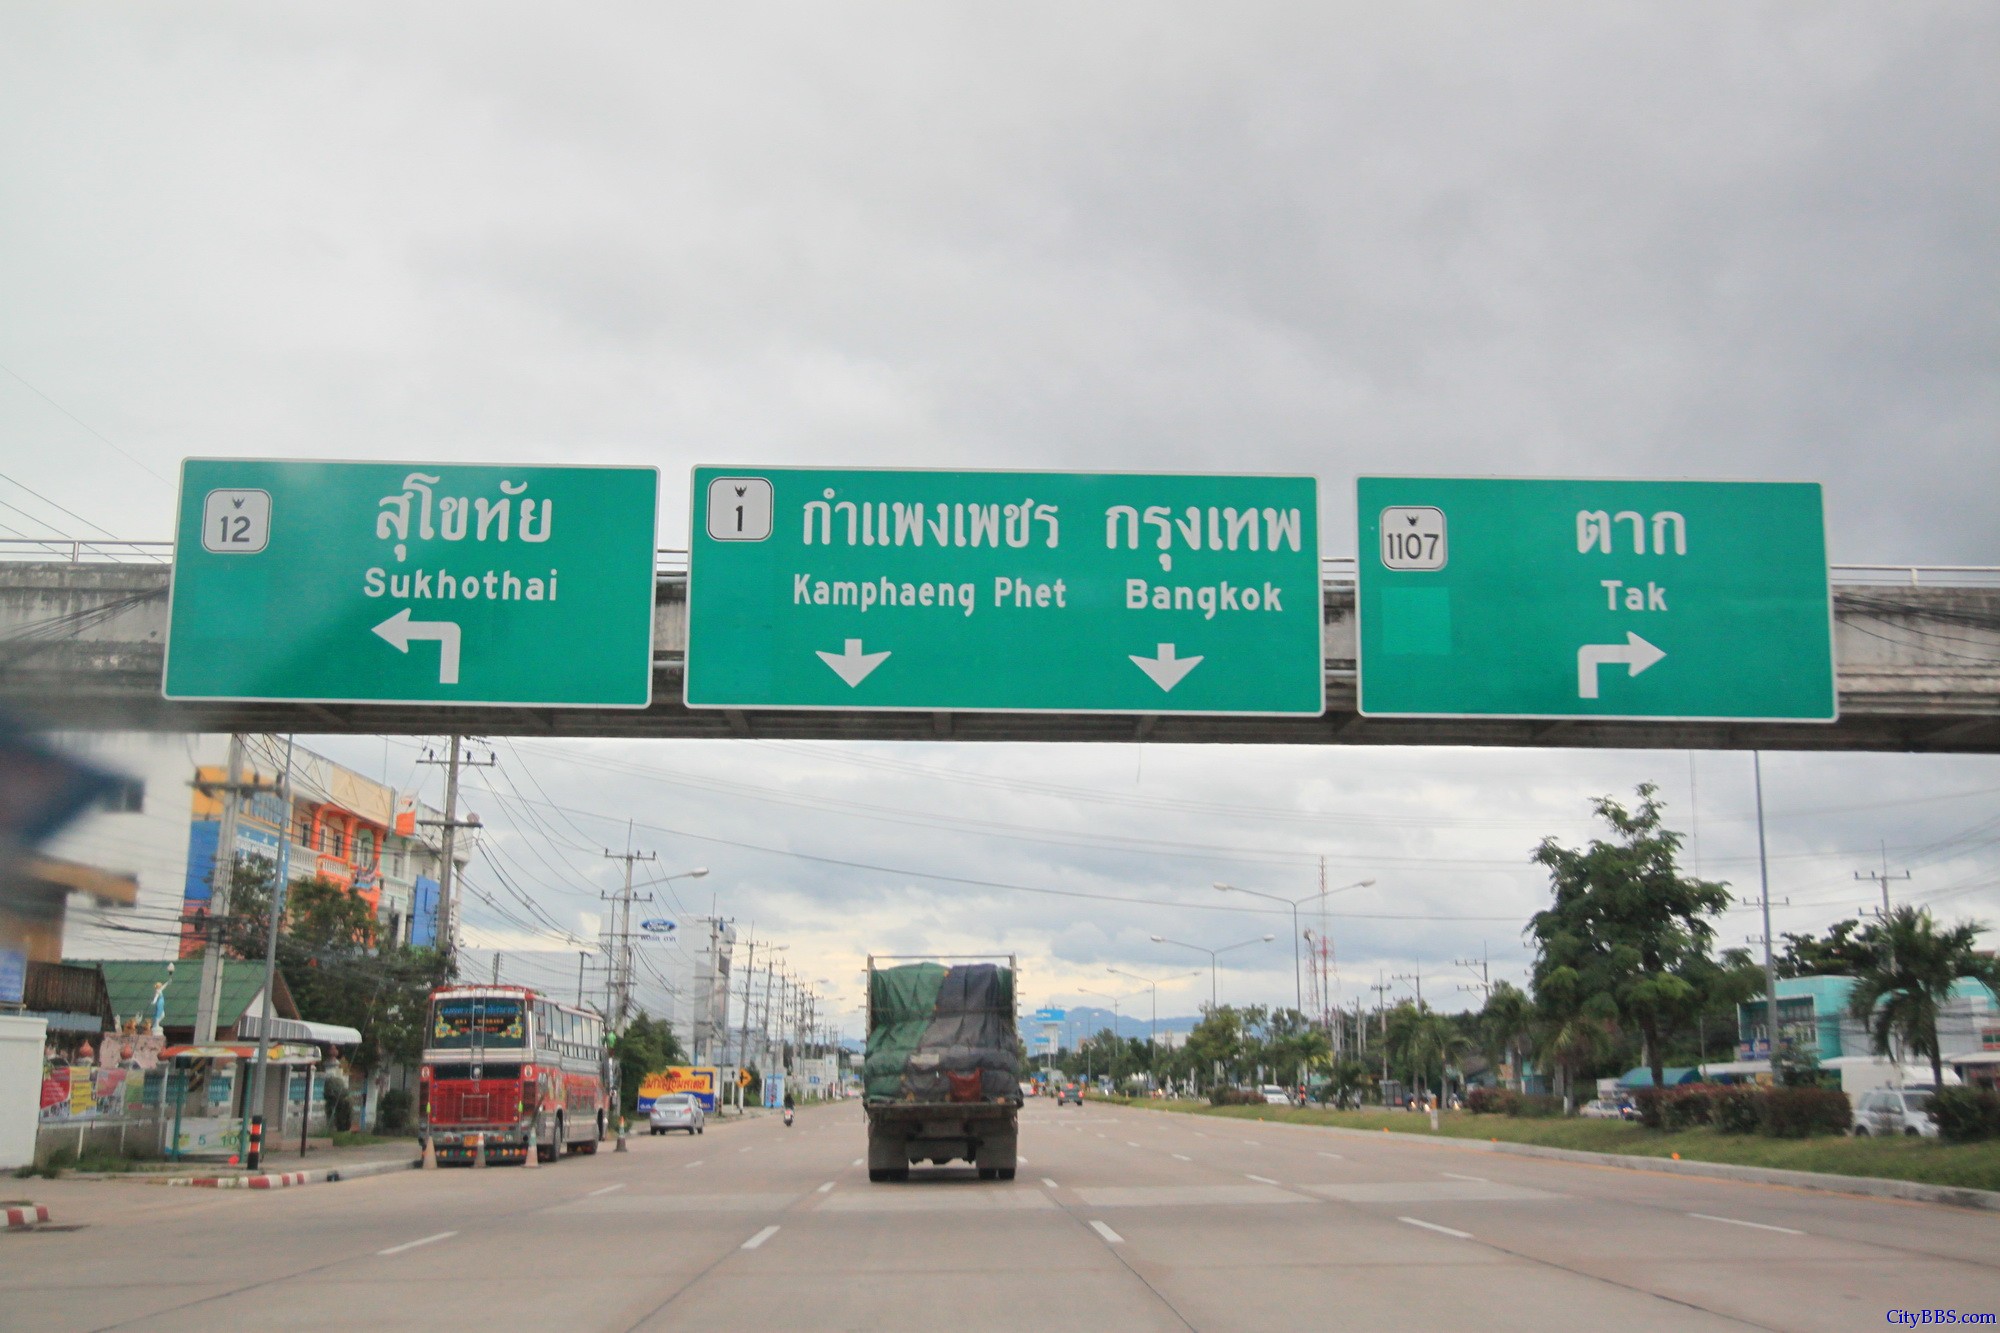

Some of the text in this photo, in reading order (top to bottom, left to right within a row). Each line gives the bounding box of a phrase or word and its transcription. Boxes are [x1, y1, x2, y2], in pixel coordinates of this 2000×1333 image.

[220, 516, 251, 543] 12
[376, 472, 553, 562] สุโขทัย
[735, 505, 744, 532] 1
[803, 488, 1059, 549] กำแพงเพชร
[1105, 504, 1301, 572] กรุงเทพ
[1576, 509, 1687, 556] ตาก
[1387, 533, 1439, 560] 1107
[364, 568, 558, 601] Sukhothai
[793, 574, 1067, 617] Kamphaeng Phet
[1126, 578, 1283, 620] Bangkok
[1600, 580, 1668, 611] Tak
